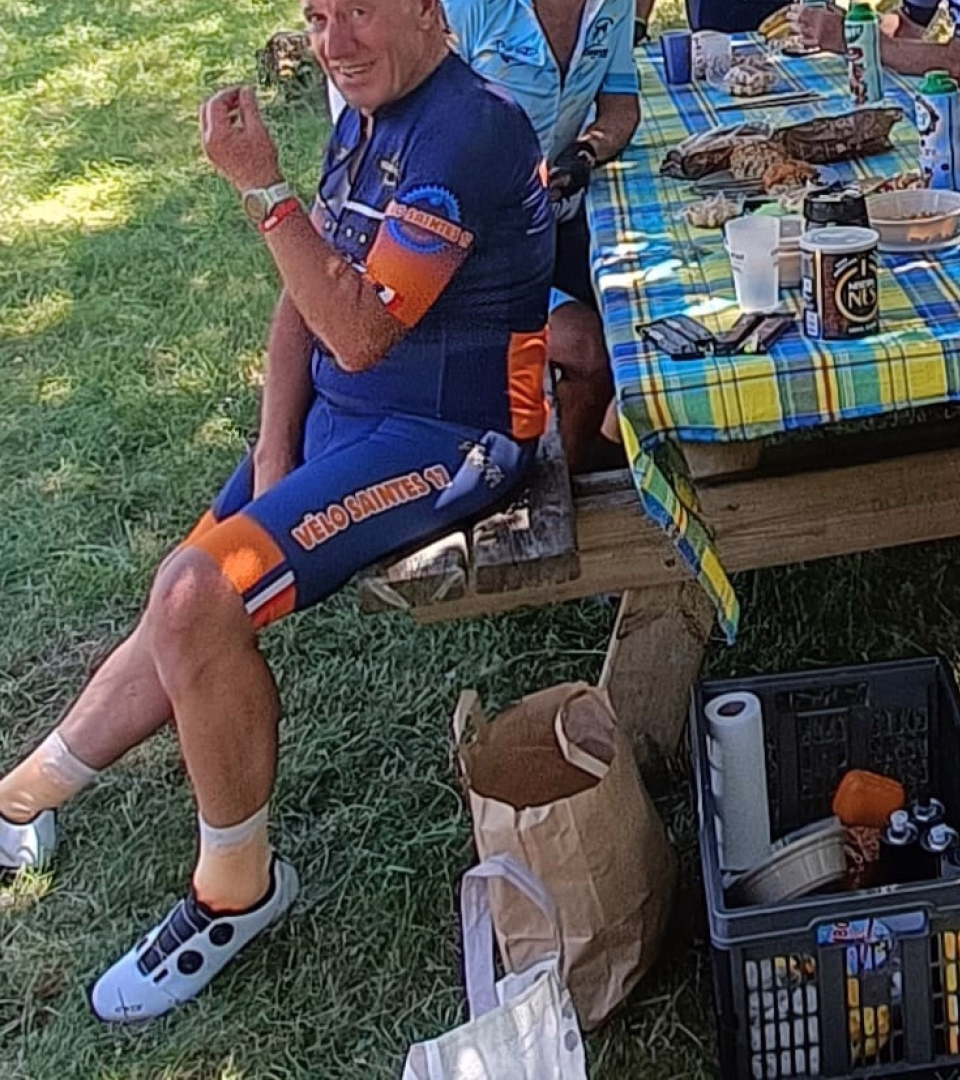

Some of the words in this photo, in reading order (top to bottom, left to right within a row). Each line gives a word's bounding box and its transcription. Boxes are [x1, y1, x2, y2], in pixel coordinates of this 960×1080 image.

[291, 503, 350, 551] VÉLO
[343, 472, 431, 522] SAINTES
[423, 464, 452, 490] 17
